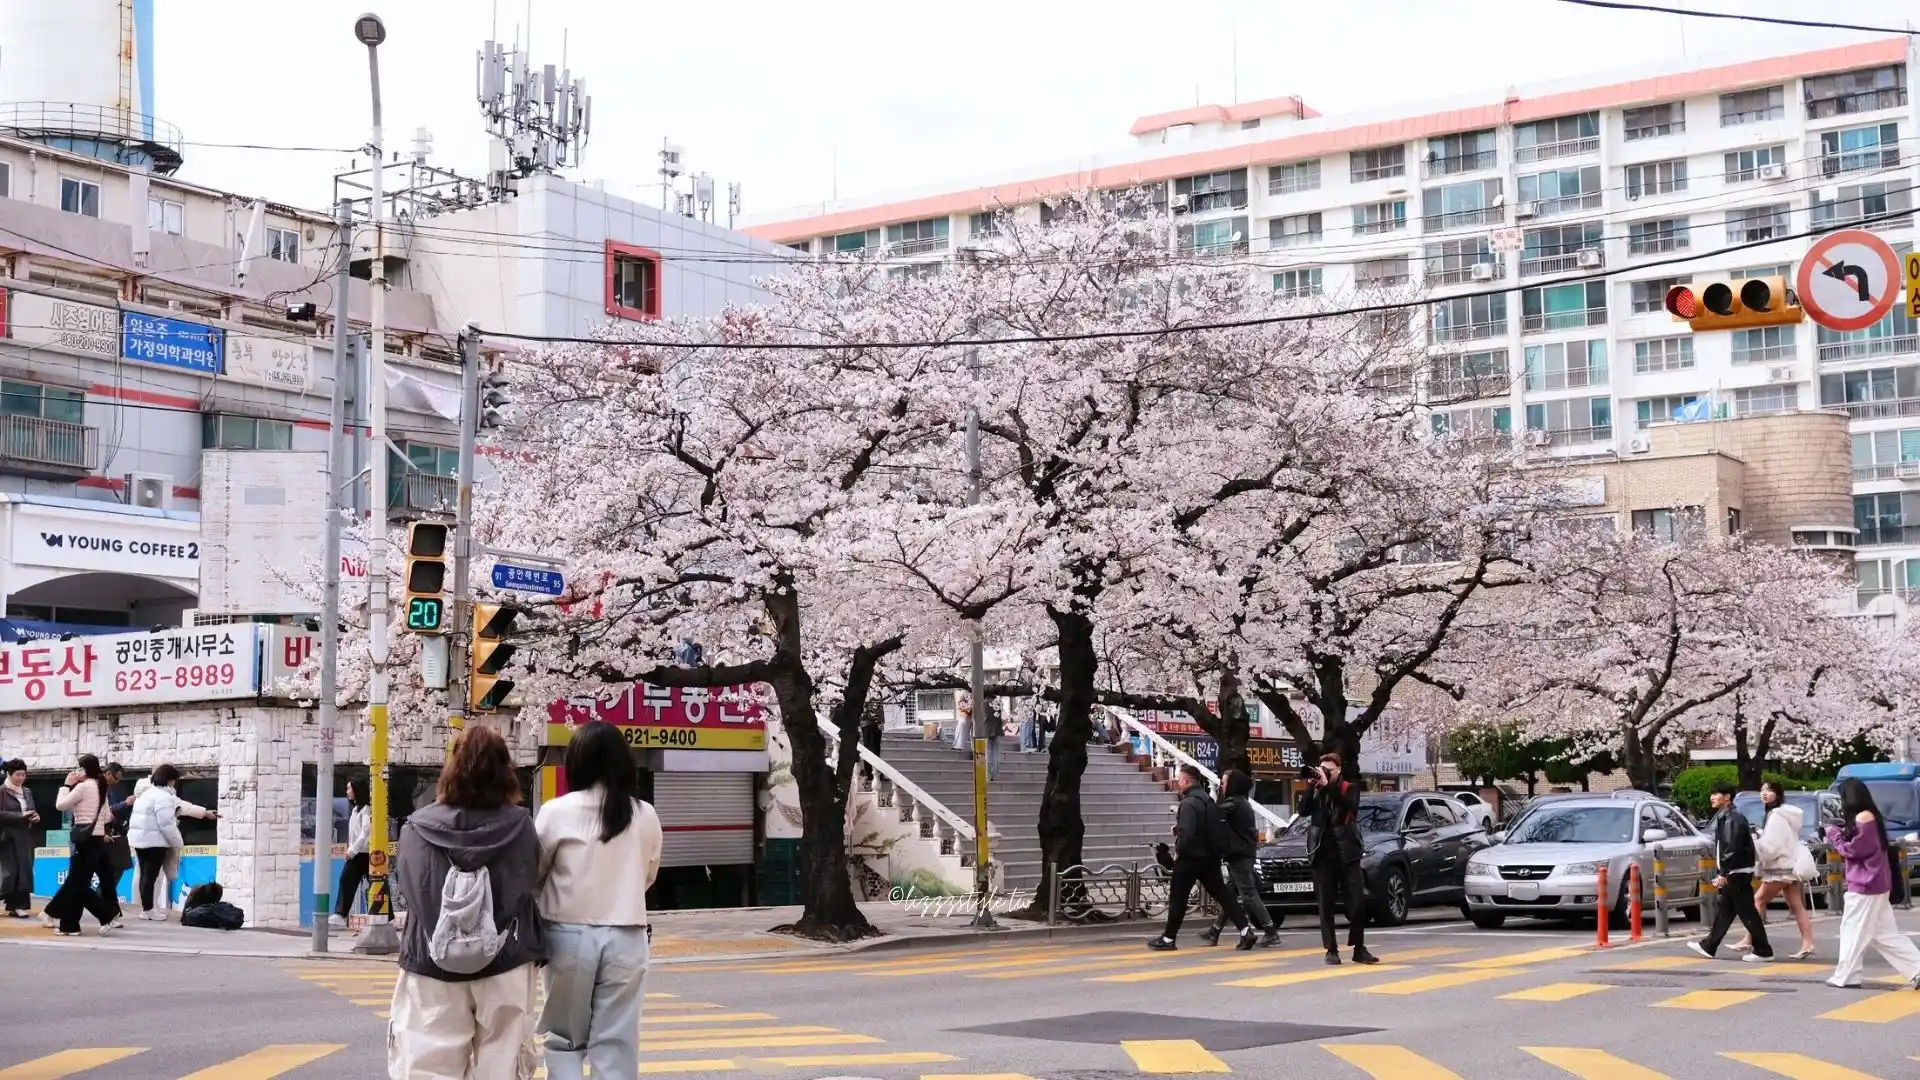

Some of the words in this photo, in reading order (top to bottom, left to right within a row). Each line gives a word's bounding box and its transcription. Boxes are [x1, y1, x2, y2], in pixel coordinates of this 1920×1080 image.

[130, 338, 216, 368] 가정의학과의원
[68, 534, 124, 553] YOUNG
[129, 541, 185, 559] COFFEE
[507, 567, 549, 583] 광안해변로
[408, 601, 438, 627] 20
[115, 631, 235, 665] 공인중개사무소
[114, 662, 235, 693] 623-8989
[624, 727, 697, 746] 621-9400
[1197, 741, 1219, 758] 624-7
